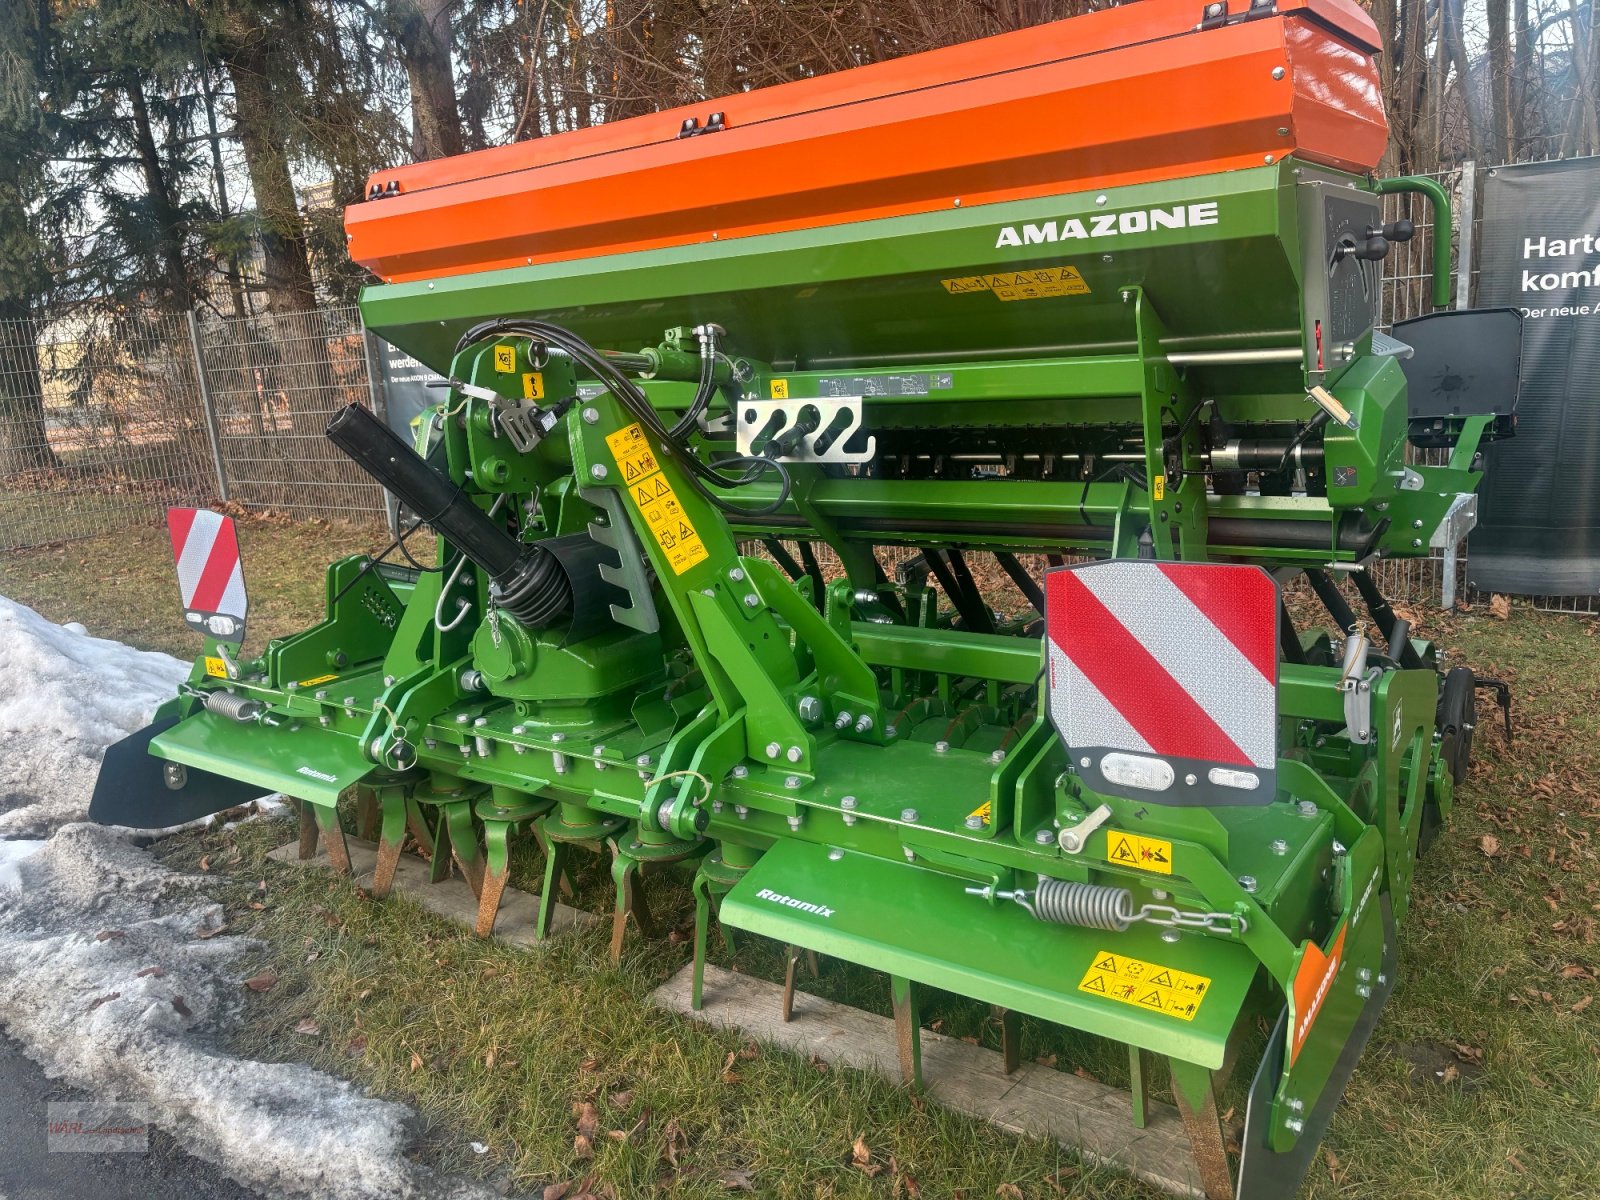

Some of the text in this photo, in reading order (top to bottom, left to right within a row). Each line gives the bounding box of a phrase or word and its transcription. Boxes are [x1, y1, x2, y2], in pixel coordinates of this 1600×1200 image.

[995, 202, 1219, 249] AMAZONE
[1521, 308, 1547, 319] Der
[1550, 305, 1590, 317] neue
[296, 766, 339, 783] Rotamix
[756, 888, 836, 918] Rotamix
[1298, 955, 1336, 1042] AMAZONE
